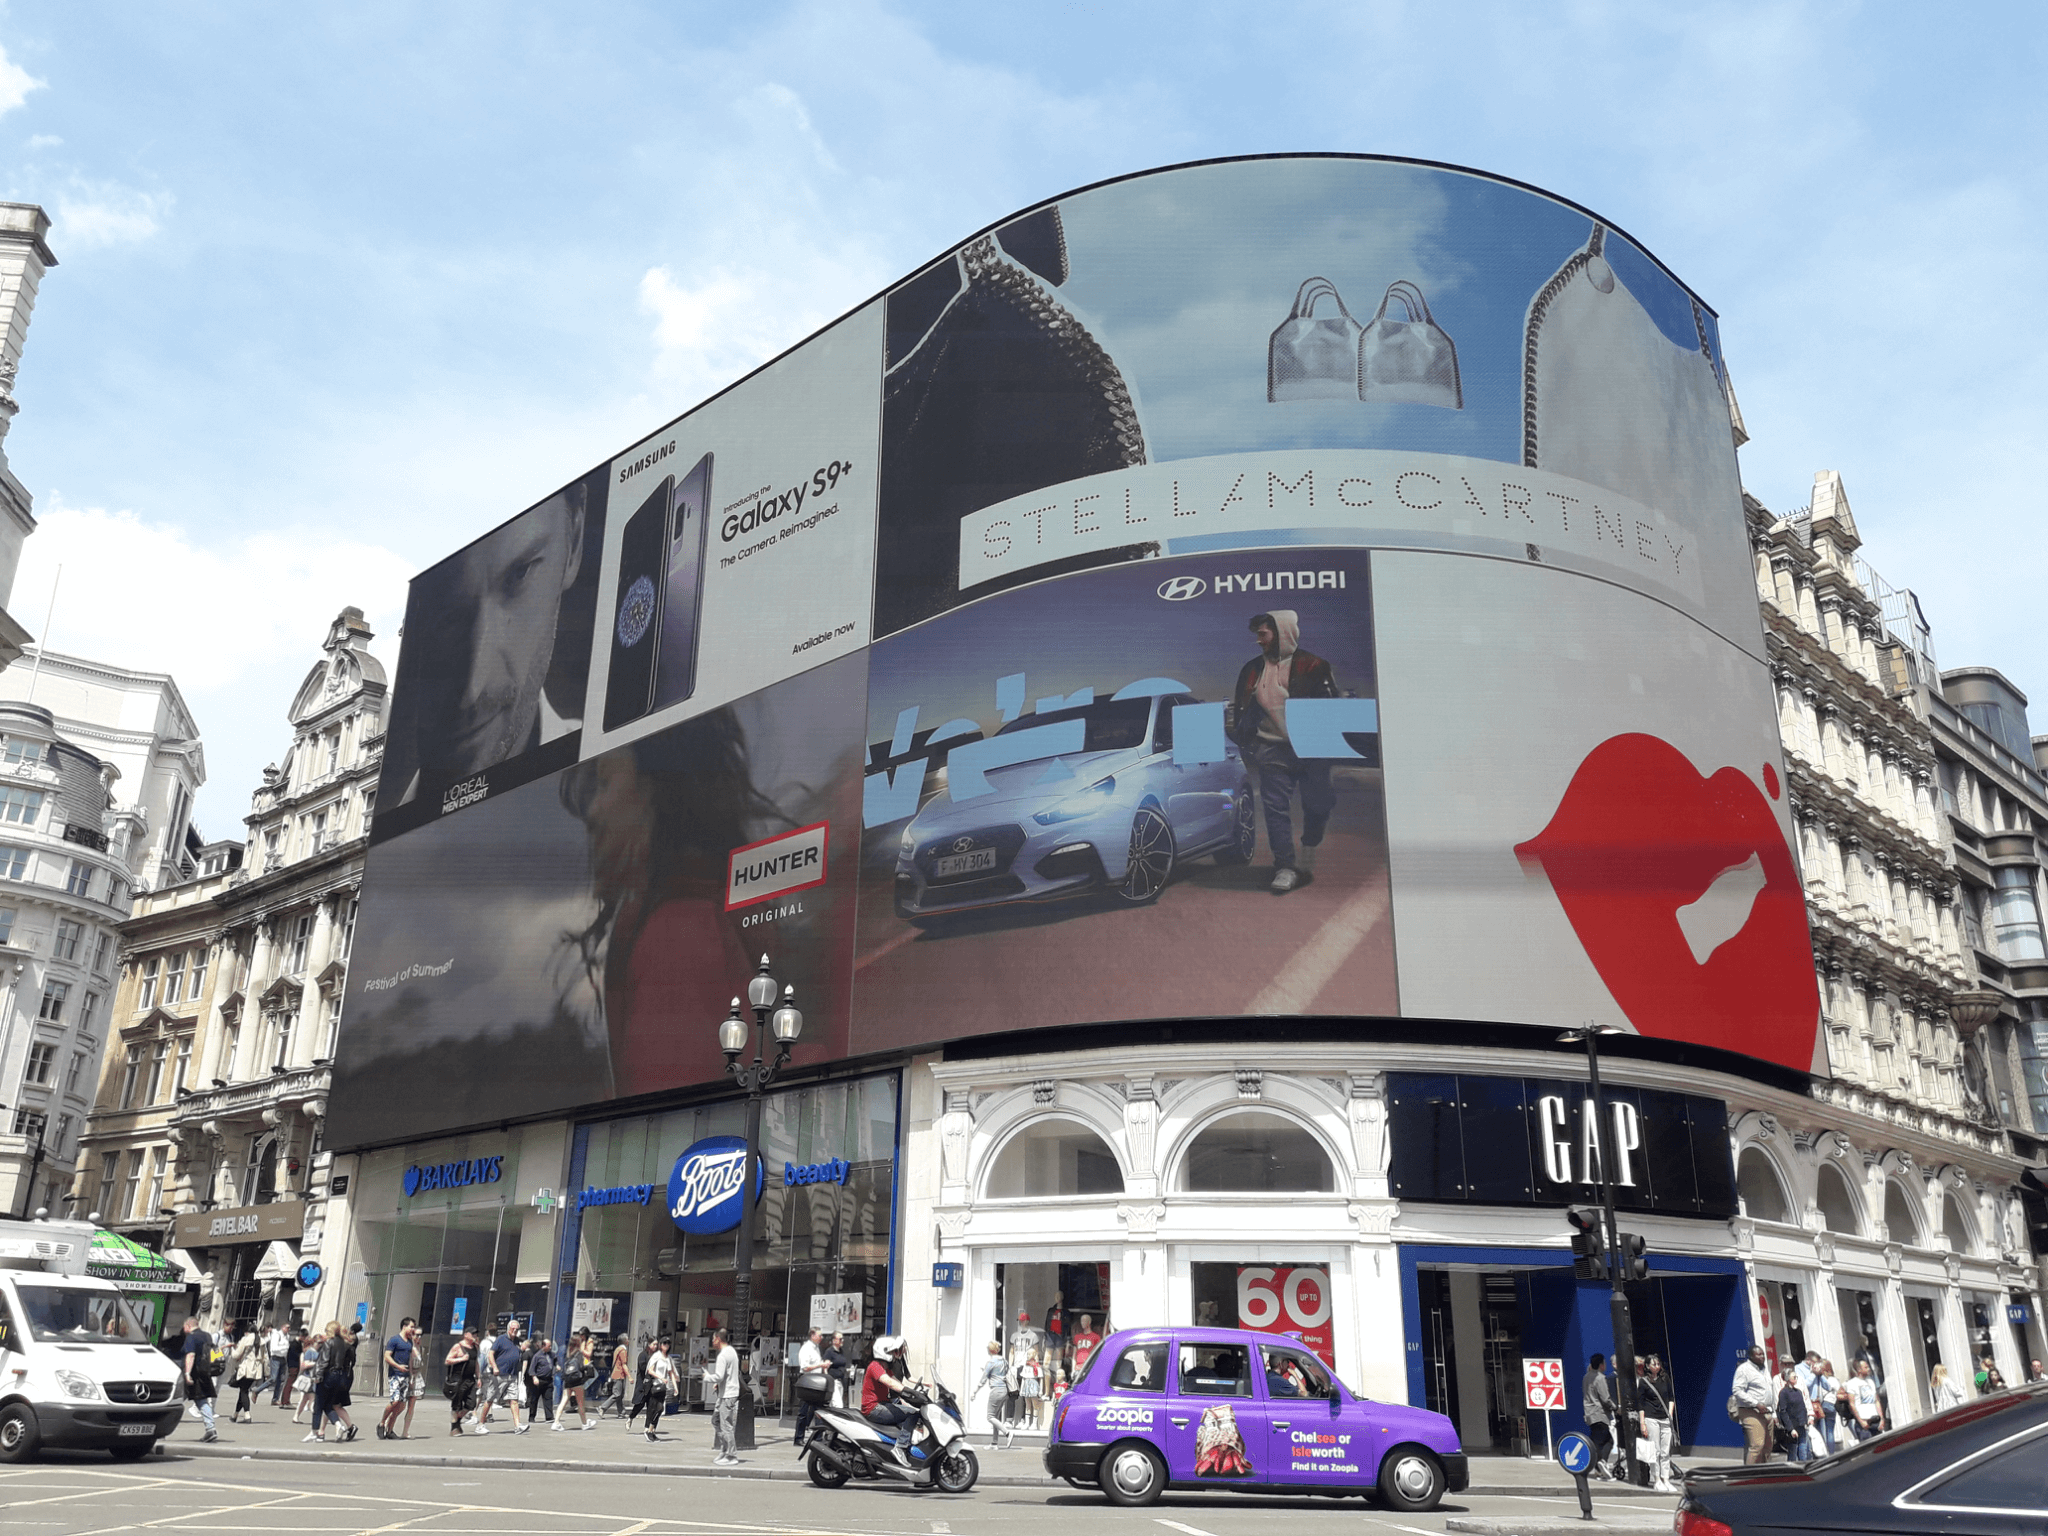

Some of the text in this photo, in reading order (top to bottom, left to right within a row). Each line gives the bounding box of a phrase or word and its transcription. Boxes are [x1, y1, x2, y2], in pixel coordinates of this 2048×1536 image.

[619, 440, 677, 484] SAMSUNG
[721, 460, 852, 543] Galaxy S9+
[722, 484, 772, 515] Introducing the
[719, 502, 840, 570] The Camera. Reimagined.
[1214, 570, 1346, 594] HYUNDAI
[792, 620, 856, 656] Available now
[441, 786, 489, 815] MEN EXPERT
[734, 846, 819, 887] HUNTER
[742, 902, 804, 928] ORIGINAL
[363, 958, 455, 993] Festival of Summer
[1539, 1095, 1640, 1187] GAP
[420, 1155, 504, 1191] BARCLAYS
[672, 1149, 747, 1218] Boots
[784, 1156, 852, 1186] beauty
[577, 1183, 655, 1213] pharmacy
[208, 1214, 259, 1237] JEWEL BAR
[85, 1266, 117, 1277] SHOW
[119, 1268, 132, 1278] IN
[935, 1268, 949, 1281] GAP
[1236, 1267, 1331, 1328] 60
[1300, 1292, 1318, 1302] UP TO
[1077, 1338, 1093, 1349] GAP
[1304, 1334, 1323, 1344] thing
[1407, 1342, 1420, 1352] GAP
[1096, 1405, 1154, 1426] Zoopla
[1291, 1430, 1352, 1445] Chelsea or
[1292, 1445, 1346, 1459] Isleworth
[1291, 1461, 1360, 1474] Find it on Zoopla
